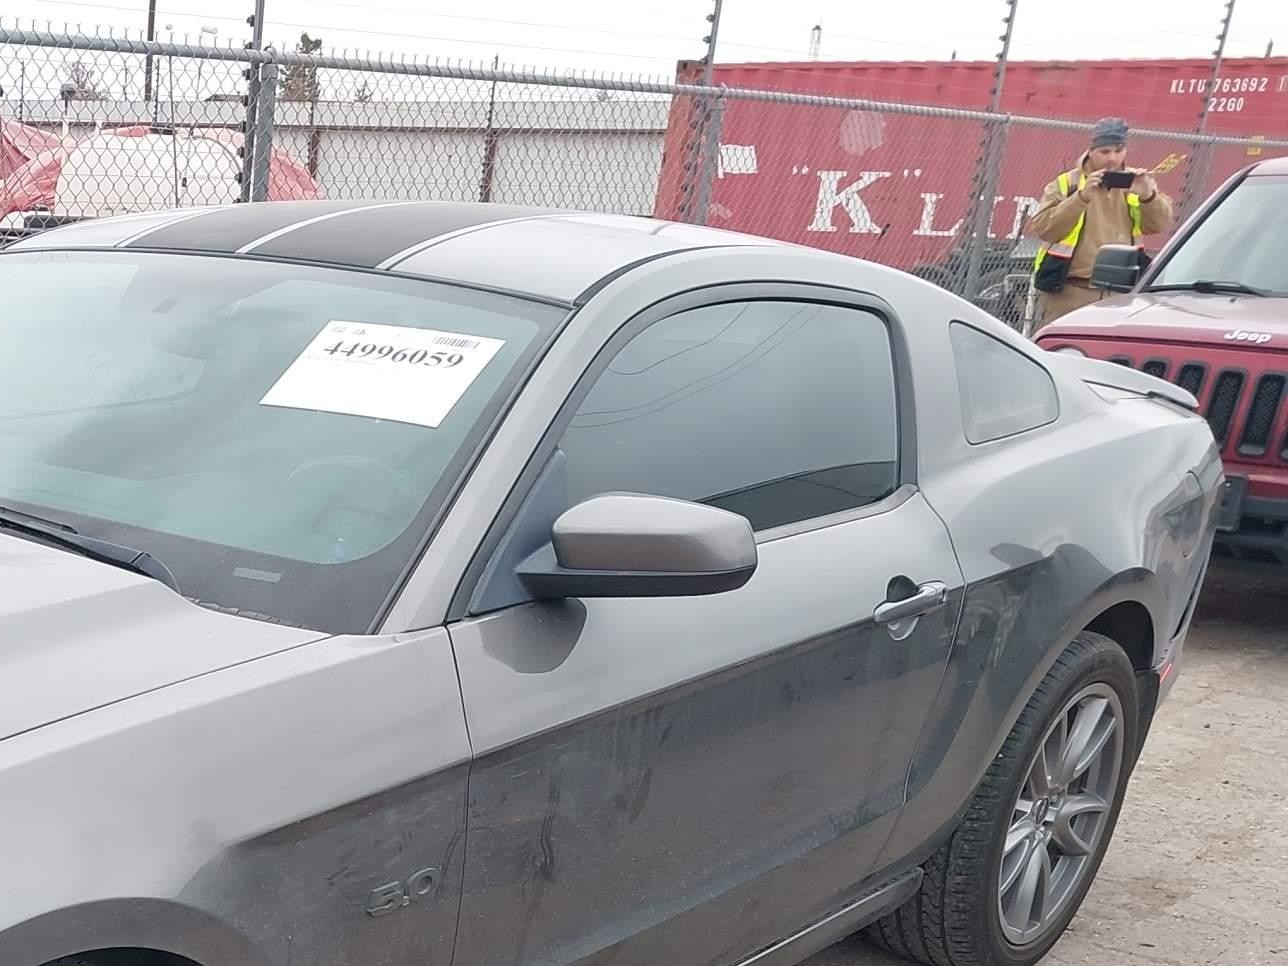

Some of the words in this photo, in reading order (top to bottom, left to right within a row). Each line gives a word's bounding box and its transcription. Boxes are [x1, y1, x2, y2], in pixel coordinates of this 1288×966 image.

[1224, 330, 1272, 344] Jeep
[324, 340, 464, 368] 44996059
[366, 866, 441, 918] 5.0
